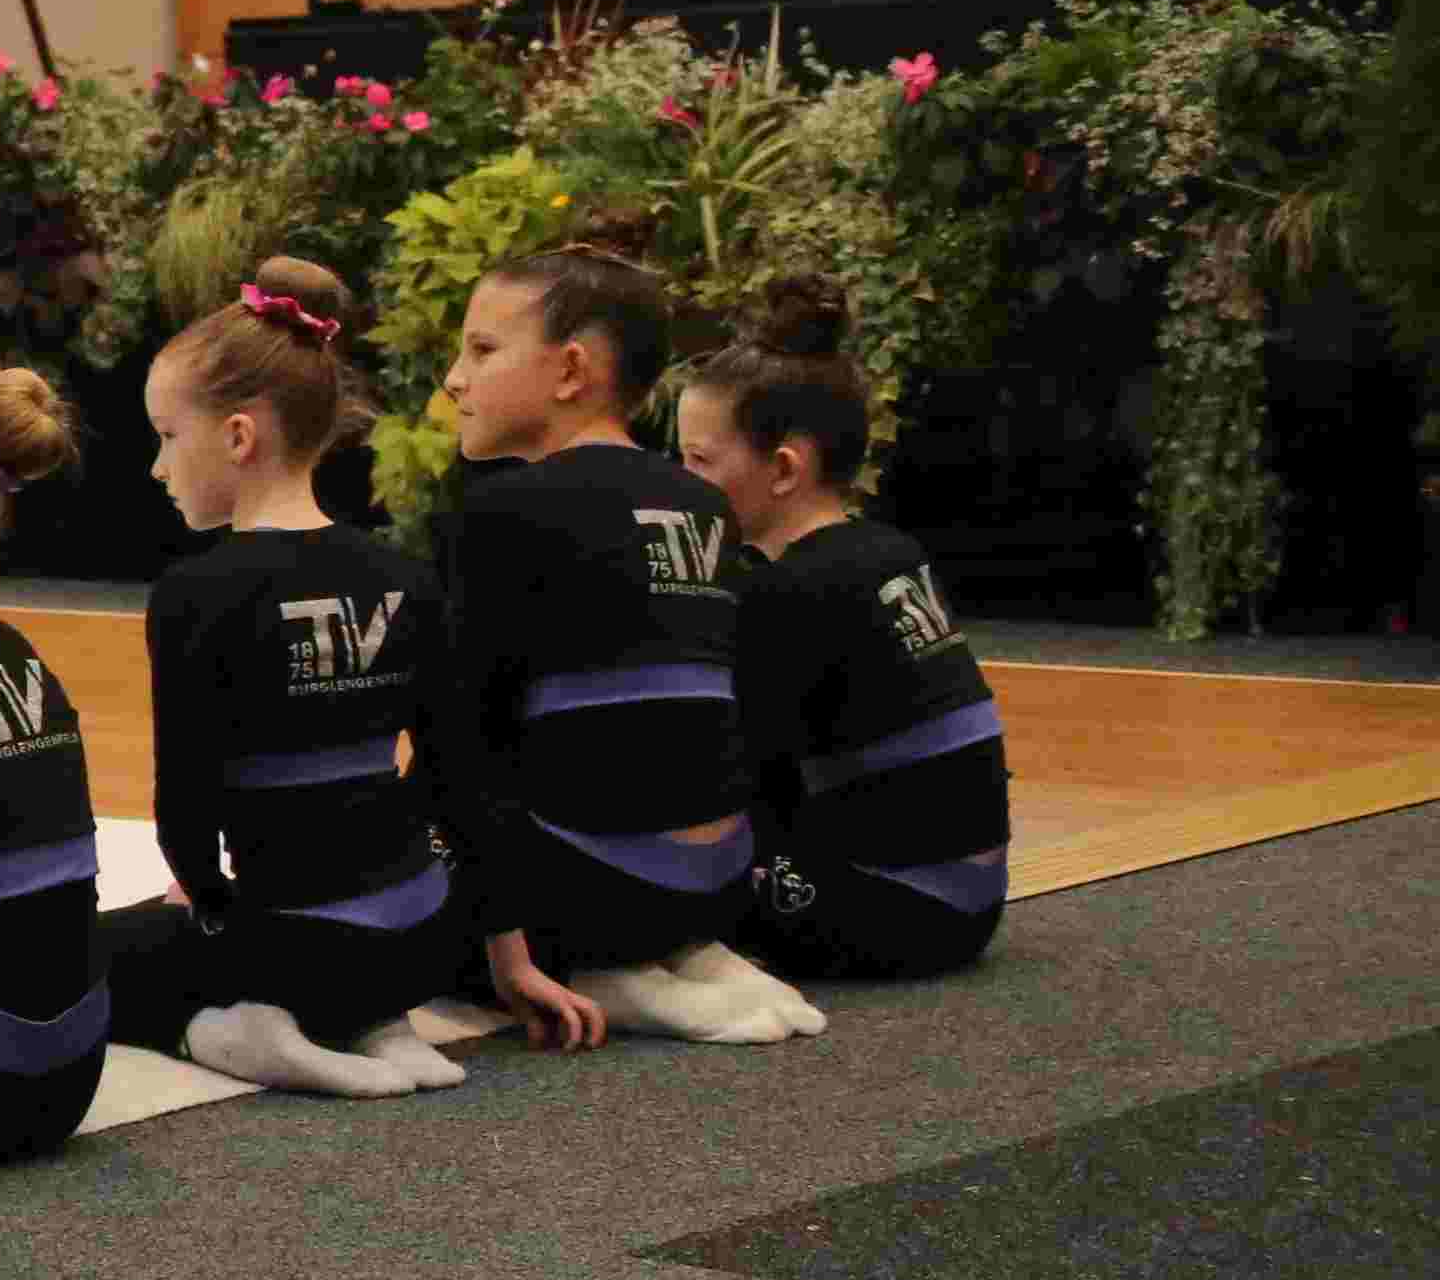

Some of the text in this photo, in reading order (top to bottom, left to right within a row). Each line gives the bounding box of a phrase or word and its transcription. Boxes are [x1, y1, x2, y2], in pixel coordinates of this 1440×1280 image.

[631, 509, 725, 583] TV
[644, 543, 668, 560] 18
[647, 561, 672, 578] 75
[279, 591, 405, 677] TV
[288, 641, 314, 660] 18
[289, 661, 315, 680] 75
